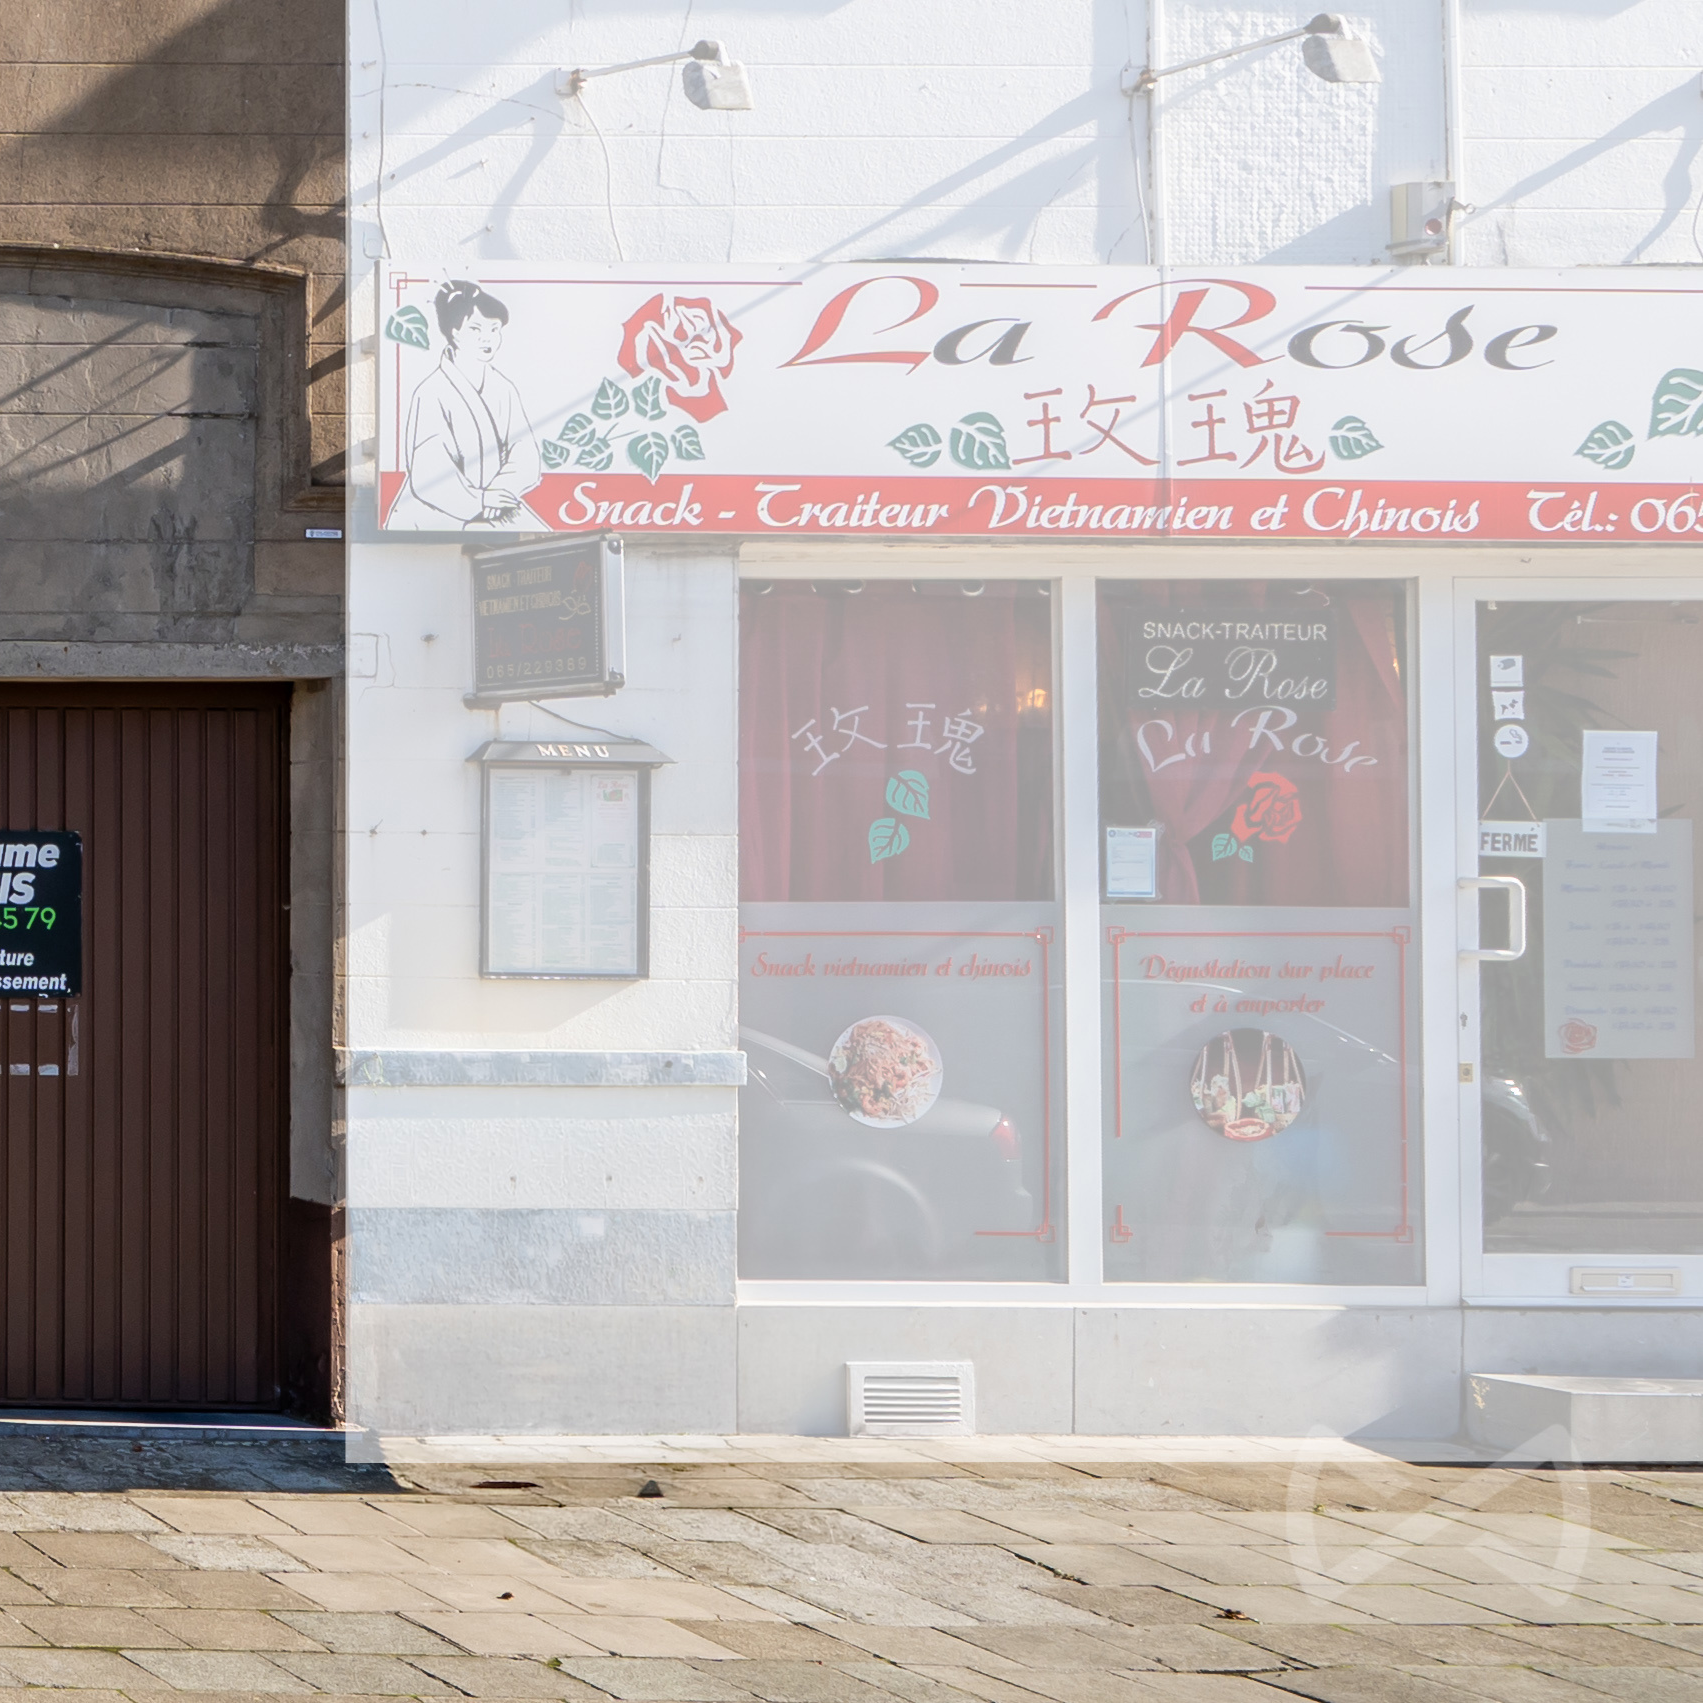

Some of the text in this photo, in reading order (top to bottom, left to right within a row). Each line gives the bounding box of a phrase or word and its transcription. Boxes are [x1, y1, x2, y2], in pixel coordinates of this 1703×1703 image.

[777, 275, 1559, 376] La Rose
[1011, 378, 1326, 475] 玫瑰
[558, 481, 703, 526] Snack
[754, 481, 949, 528] Traiteur
[968, 484, 1232, 531] Vietnamien
[1249, 494, 1288, 531] et
[1302, 486, 1480, 539] Chinois
[1630, 492, 1703, 533] 06
[487, 573, 512, 591] SNACK
[519, 623, 582, 654] Rose
[1143, 621, 1328, 641] SNACK-TRAITEUR
[1138, 645, 1328, 700] La Rose
[535, 744, 610, 759] MENU
[791, 703, 984, 775] 玫瑰
[1230, 705, 1378, 773] Rose
[1480, 827, 1539, 853] FERMÉ
[25, 906, 57, 930] 79
[751, 951, 1033, 982] Snack vietnamien et chinois
[1139, 954, 1375, 983] Dégustation sur place
[1189, 993, 1326, 1017] et à emporter
